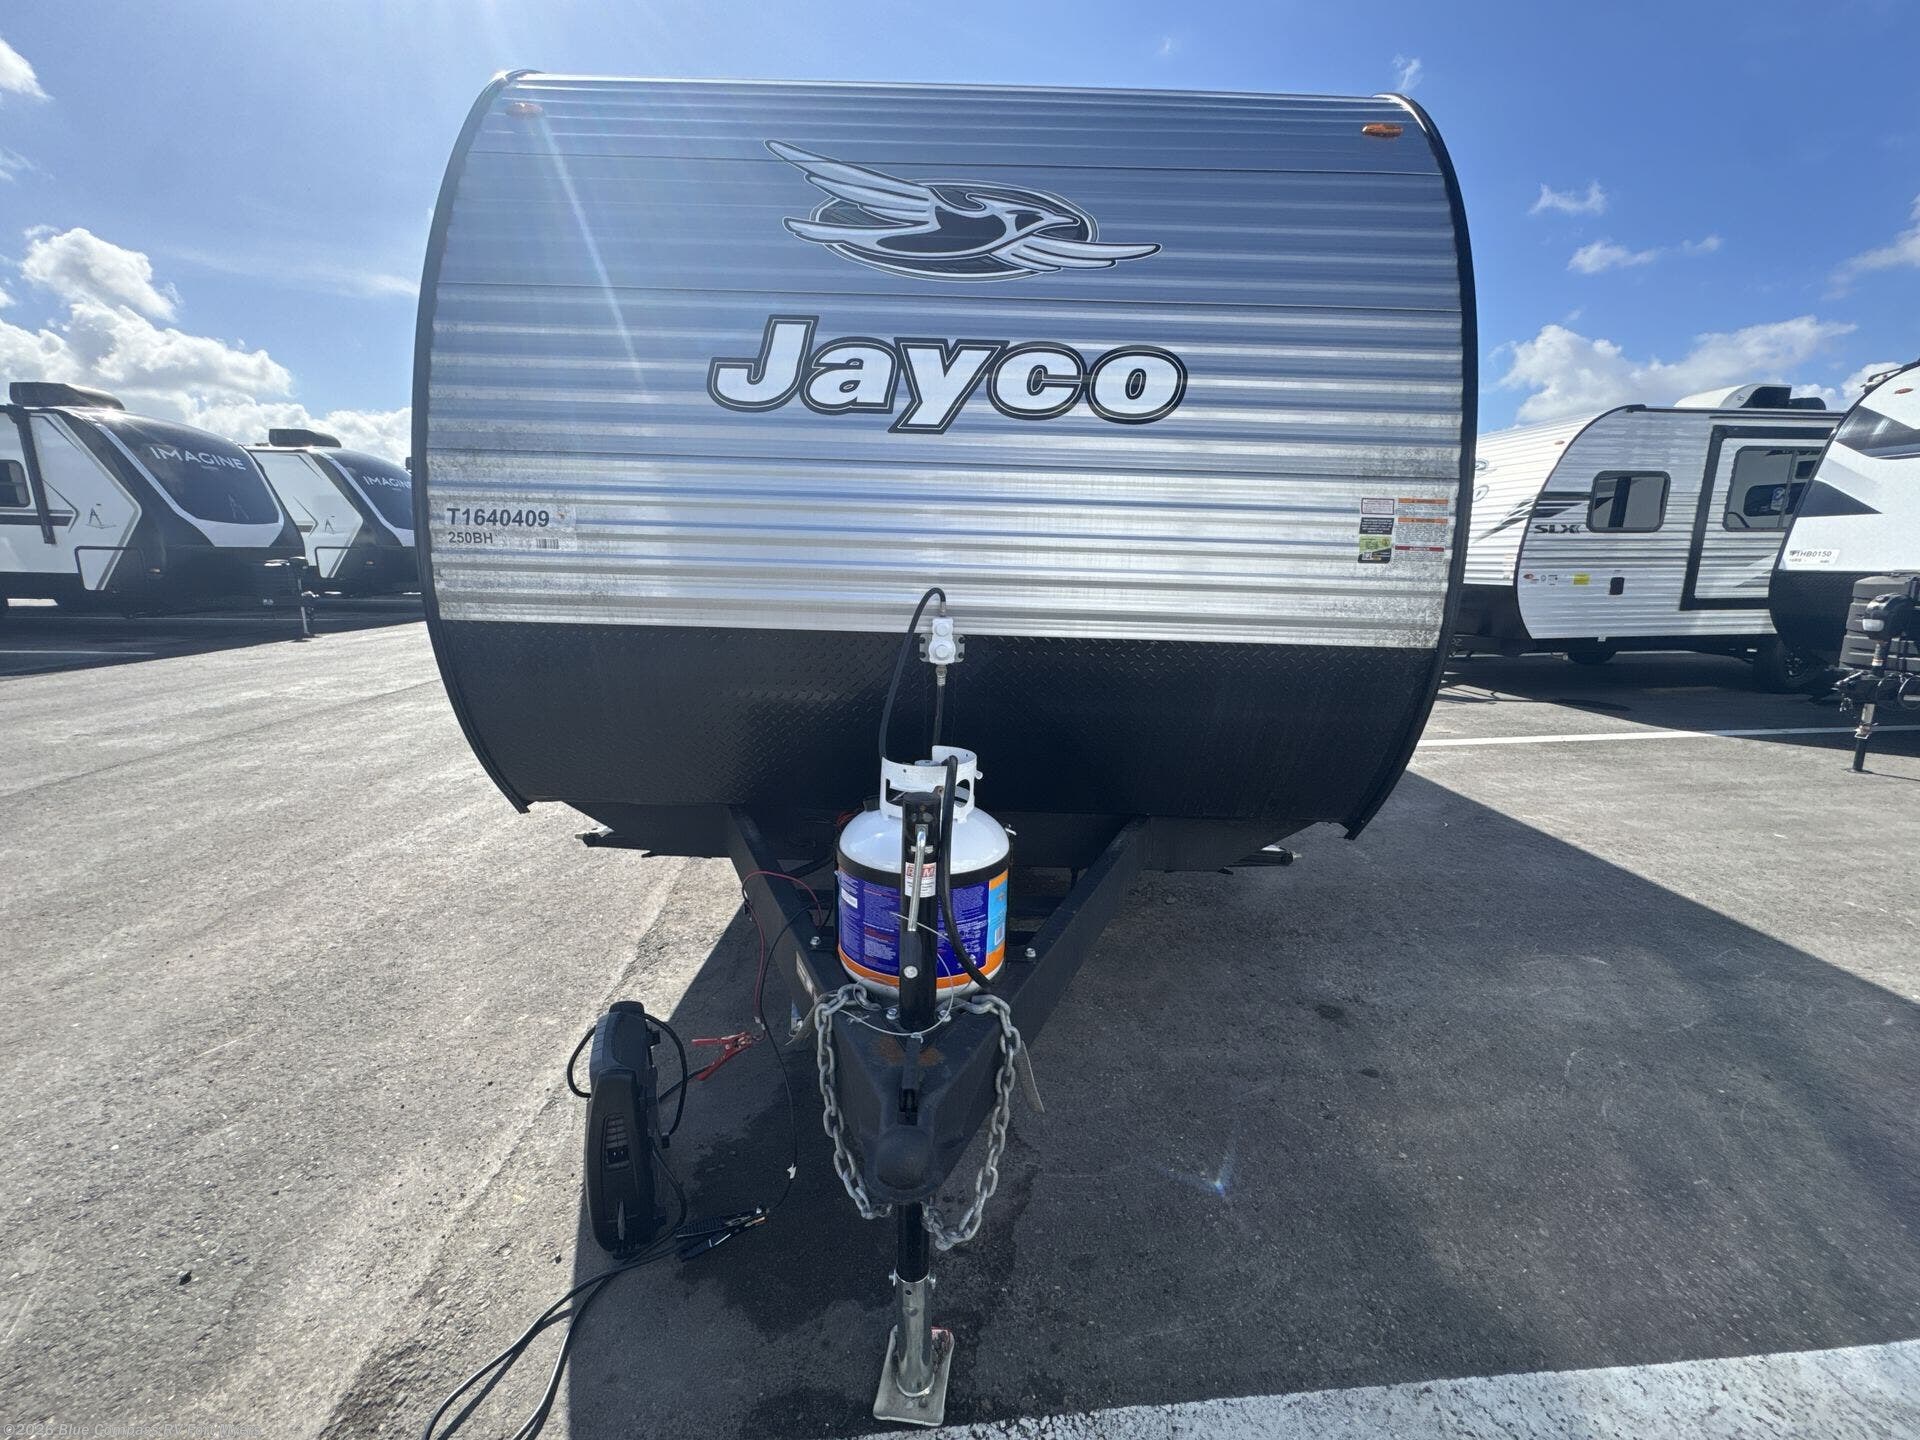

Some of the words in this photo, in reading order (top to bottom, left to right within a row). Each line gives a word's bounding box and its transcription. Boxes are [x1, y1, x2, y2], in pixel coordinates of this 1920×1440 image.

[707, 314, 1189, 434] Jayco
[149, 446, 247, 471] IMAGINE
[446, 507, 550, 528] T1640409
[447, 531, 493, 544] 250BH
[1533, 524, 1576, 534] SLX
